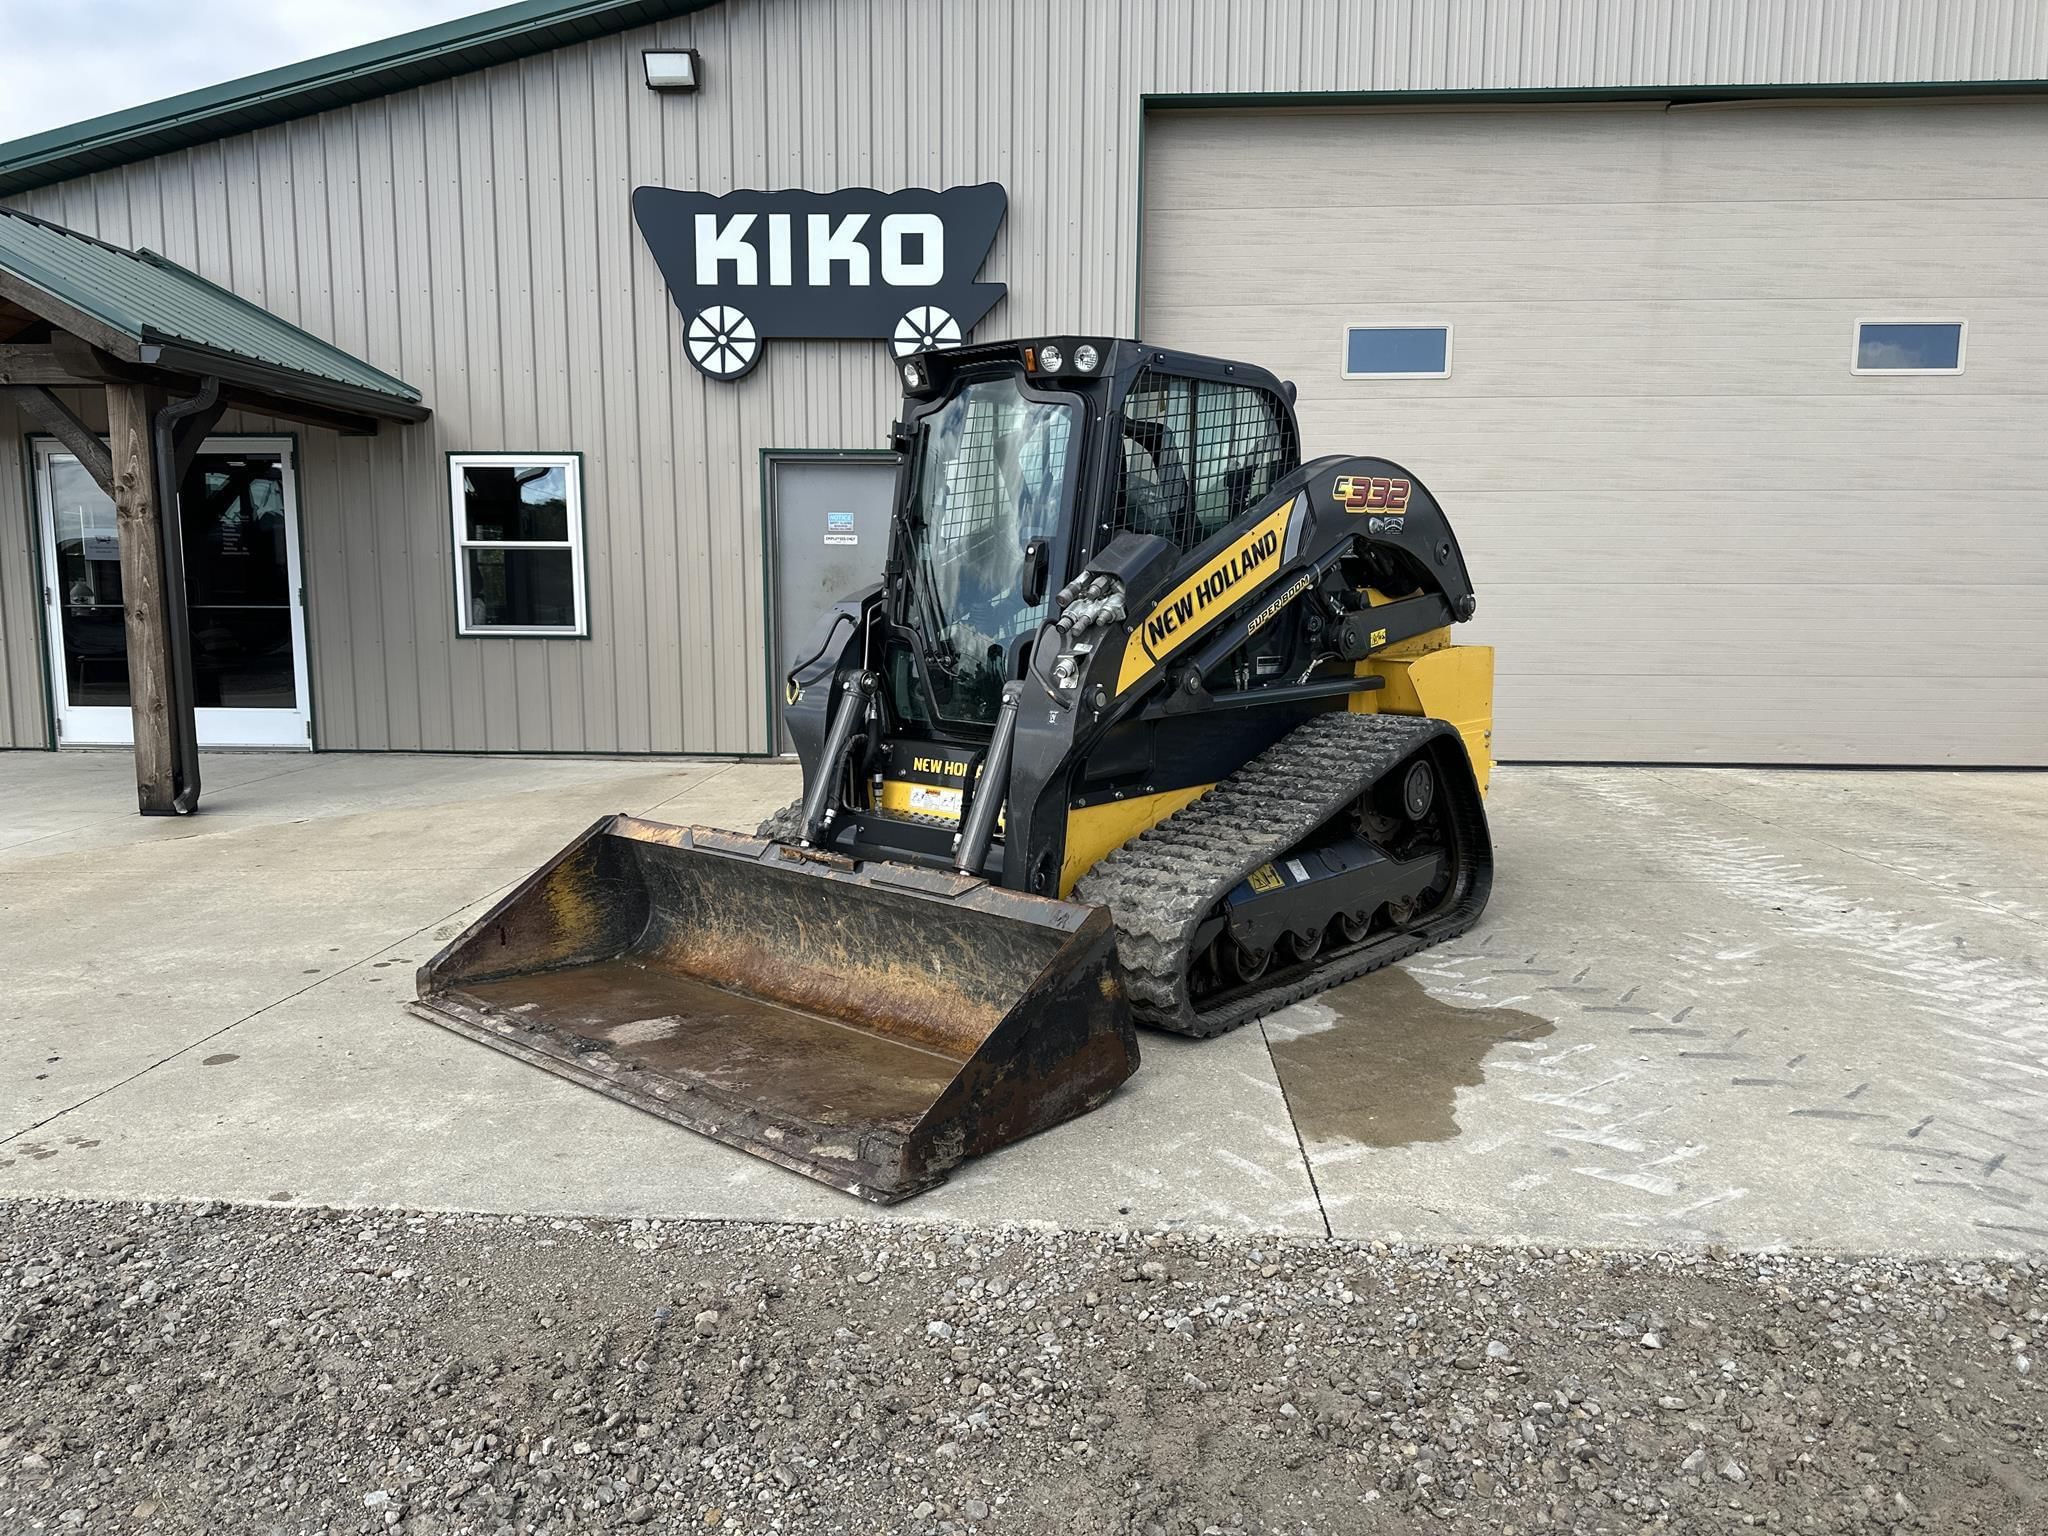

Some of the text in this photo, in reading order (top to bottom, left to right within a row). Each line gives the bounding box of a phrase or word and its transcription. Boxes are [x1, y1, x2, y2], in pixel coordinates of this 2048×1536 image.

[694, 213, 944, 286] KIKO
[1333, 475, 1411, 513] C332
[1148, 529, 1277, 647] NEW HOLLAND
[1248, 573, 1310, 635] SUPER BOOM
[913, 757, 942, 774] NEW
